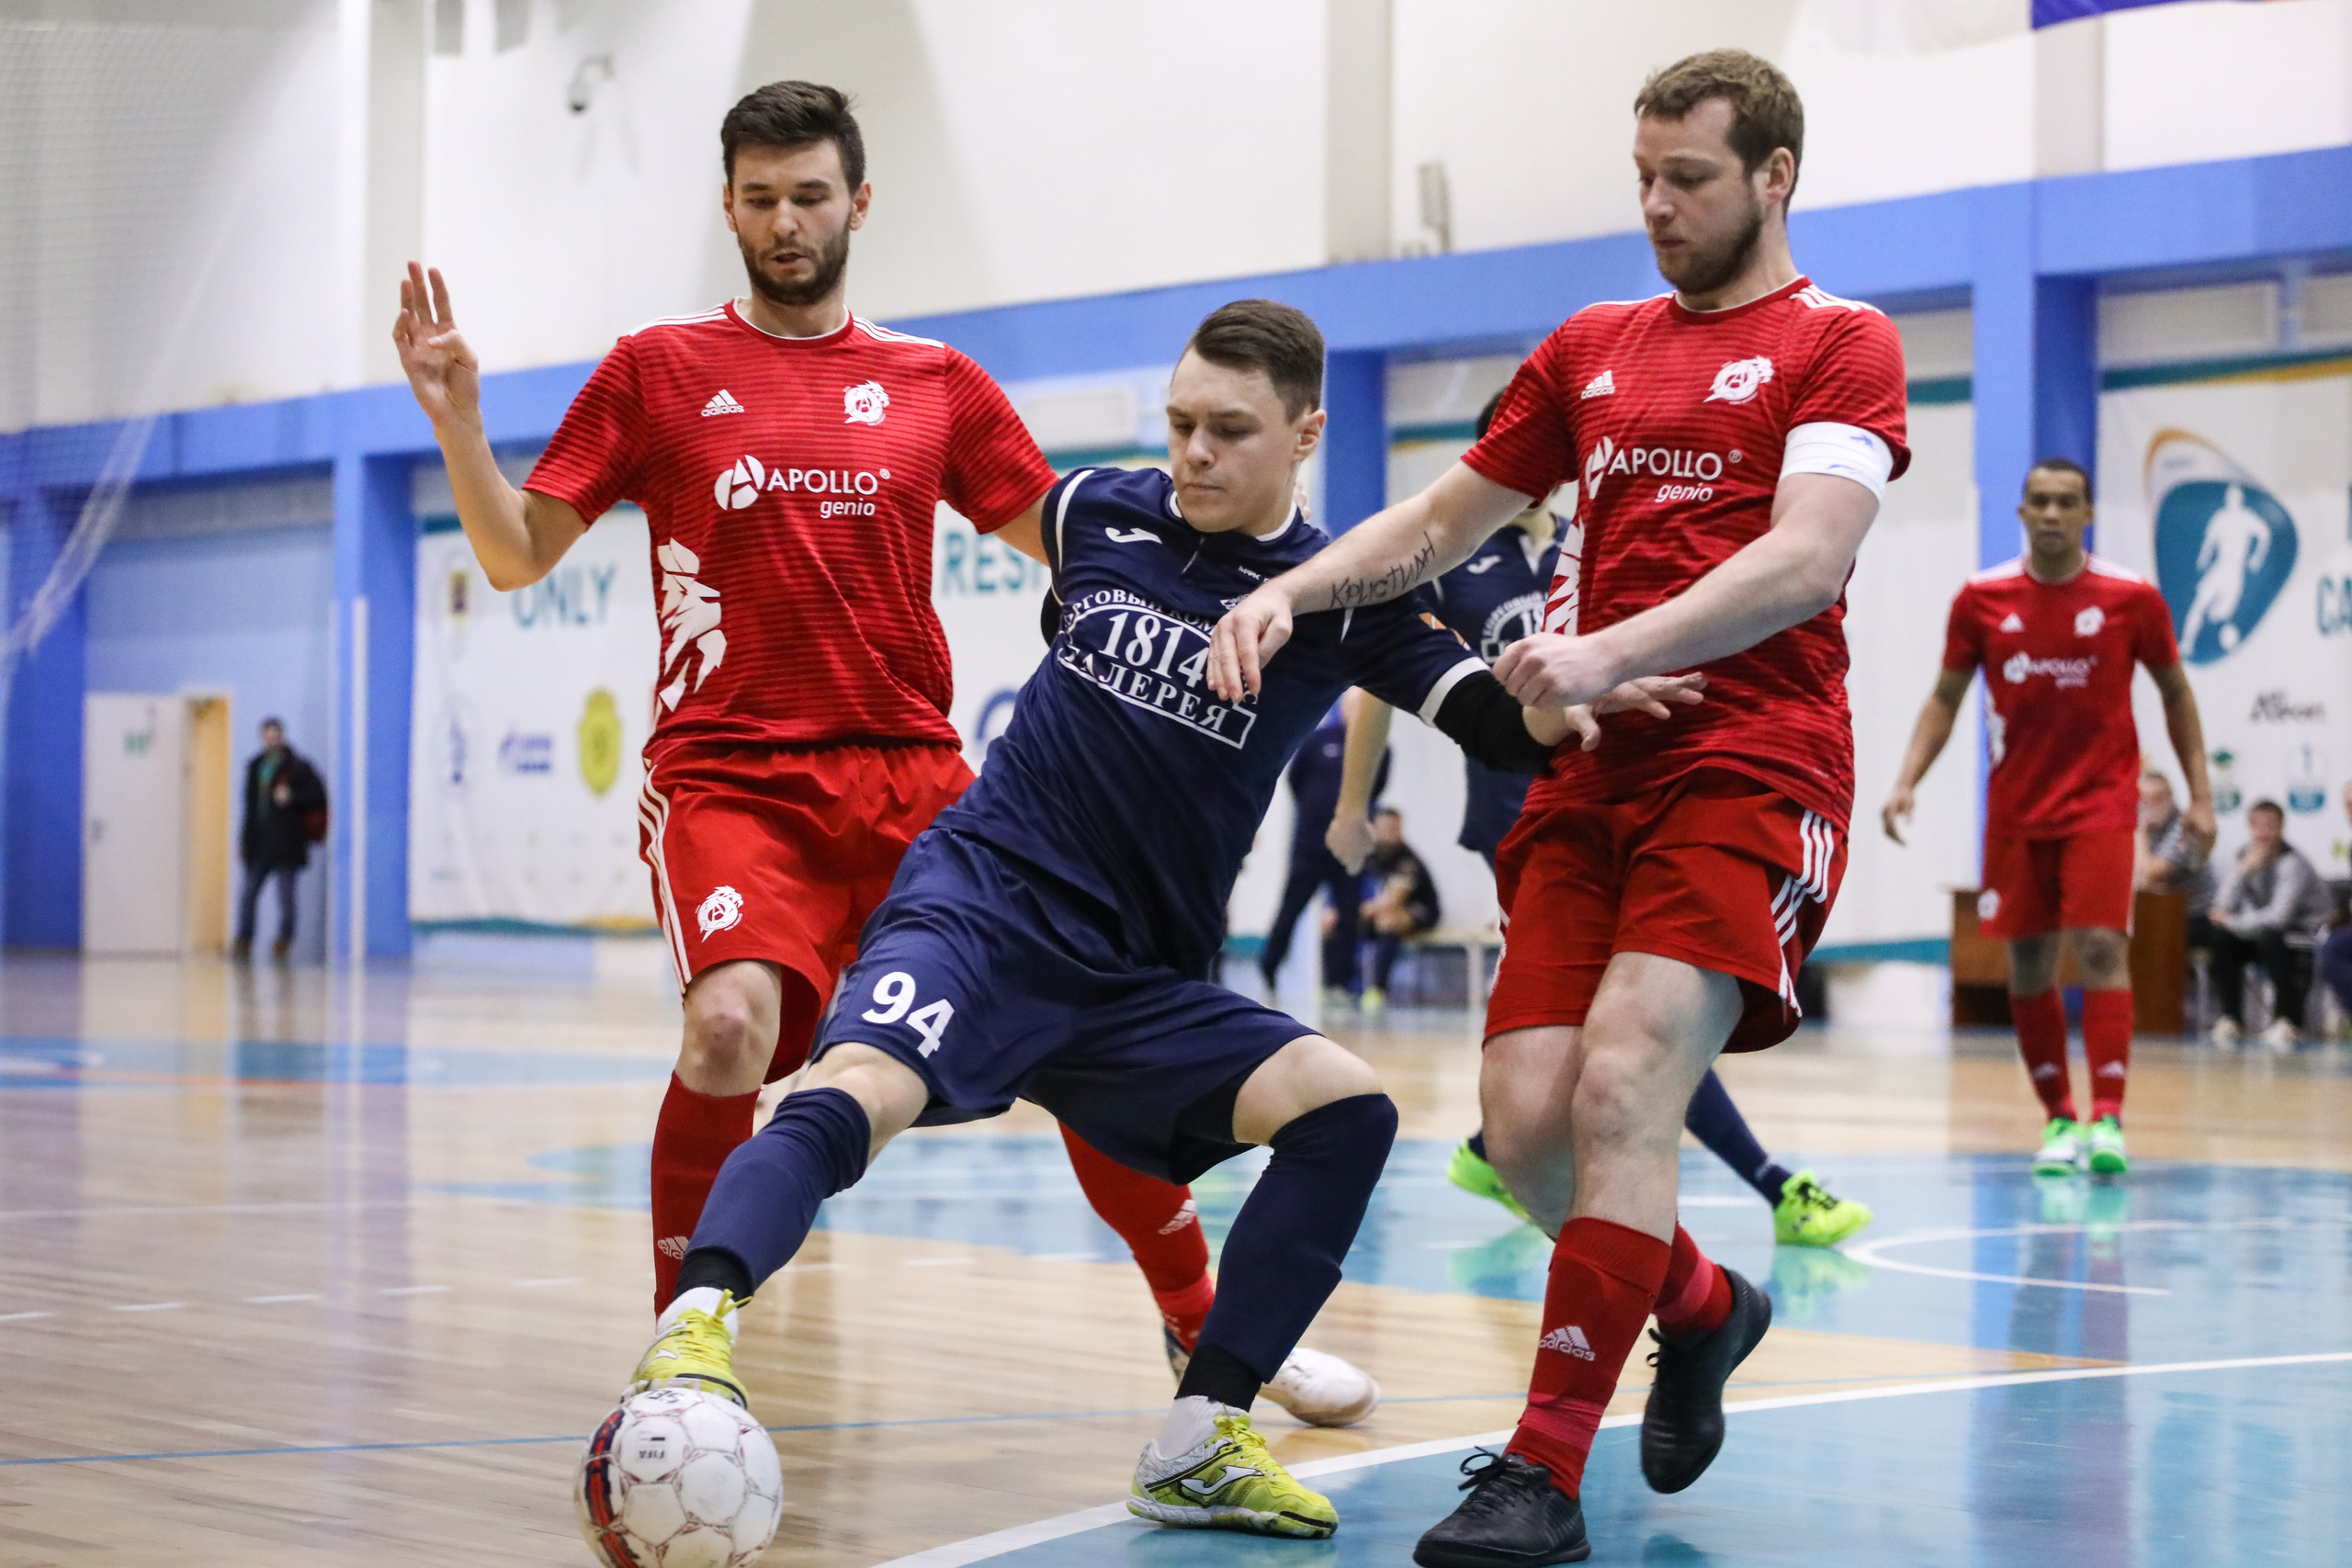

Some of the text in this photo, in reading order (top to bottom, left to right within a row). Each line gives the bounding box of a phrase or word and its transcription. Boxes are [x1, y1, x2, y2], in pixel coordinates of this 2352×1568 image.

[1580, 385, 1616, 400] adidas
[700, 404, 745, 417] adidas
[1607, 447, 1723, 480] APOLLO
[766, 468, 878, 495] APOLLO
[1655, 482, 1713, 502] genio
[820, 497, 876, 519] genio
[1098, 612, 1209, 689] 1814
[861, 971, 956, 1059] 94
[1539, 1338, 1596, 1361] adidas
